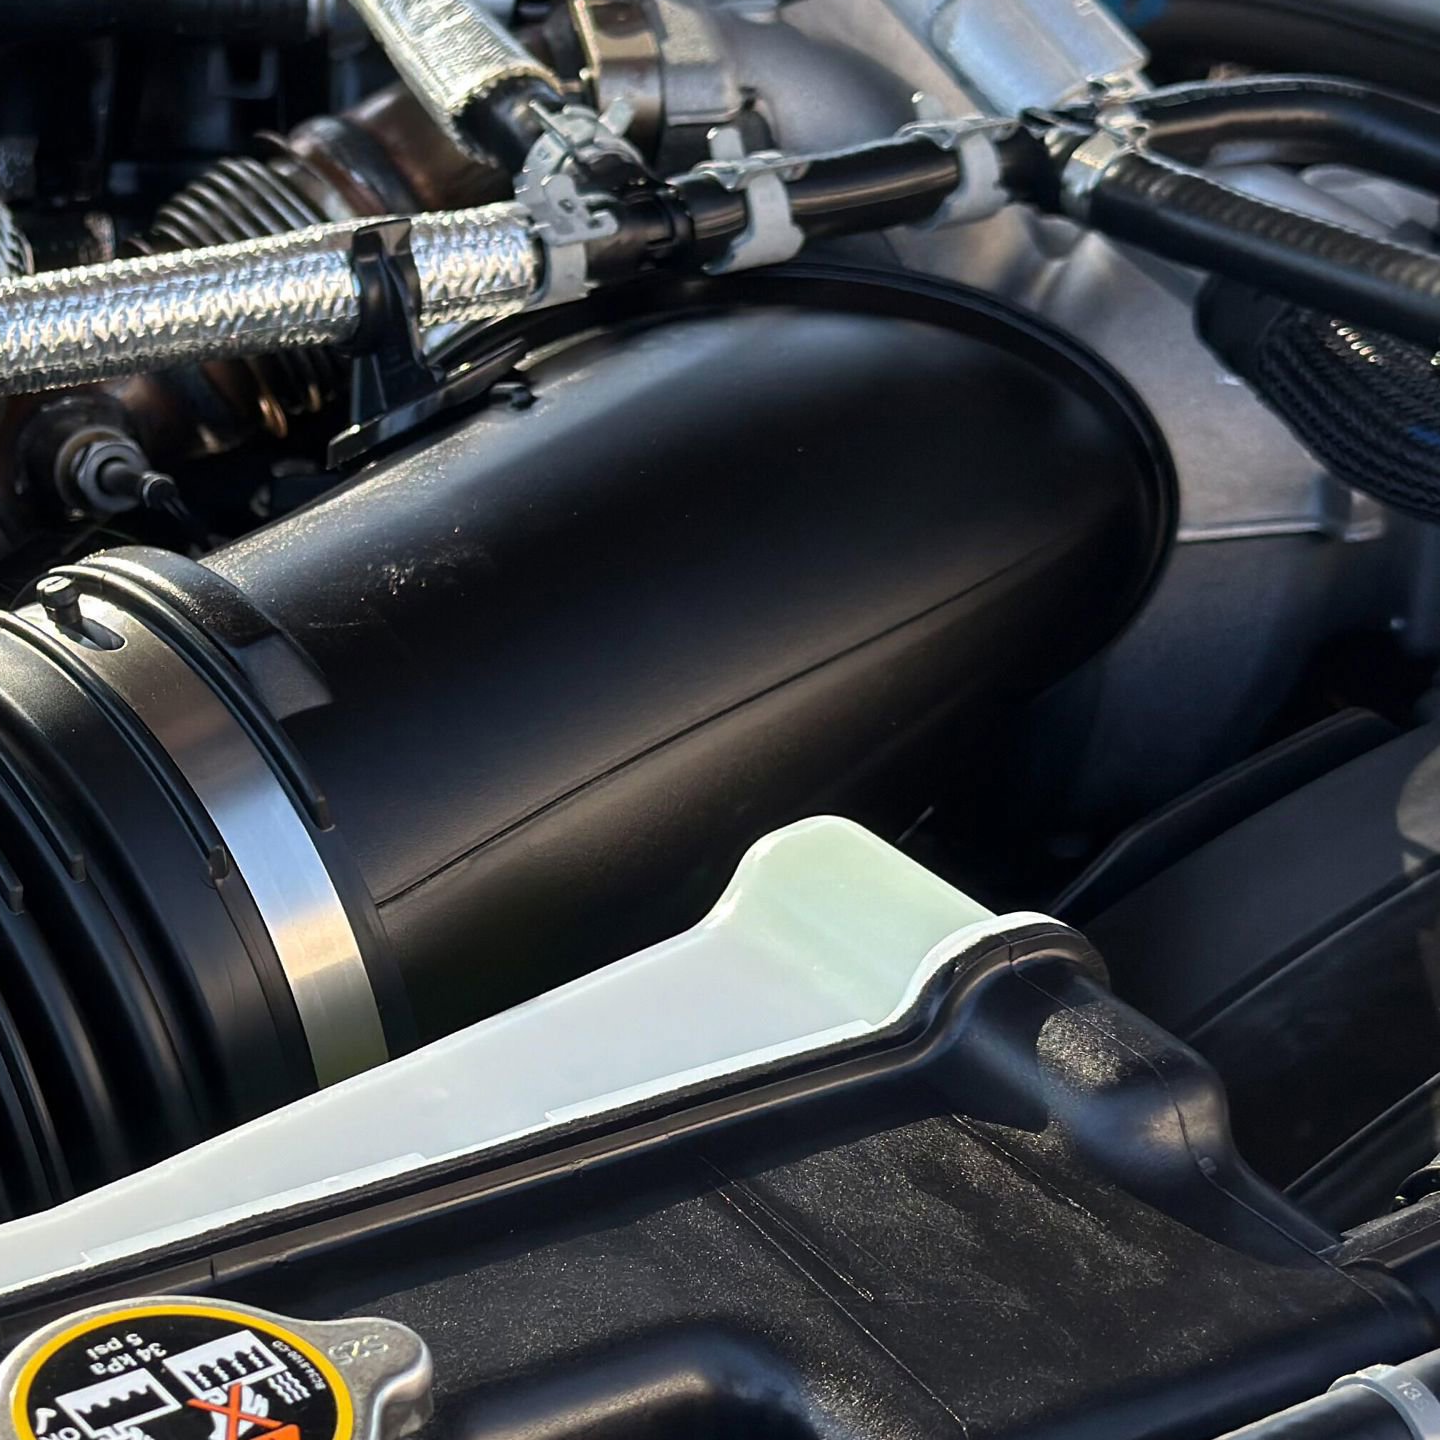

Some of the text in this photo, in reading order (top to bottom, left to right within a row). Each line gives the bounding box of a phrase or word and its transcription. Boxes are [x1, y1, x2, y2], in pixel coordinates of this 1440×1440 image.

[85, 1331, 143, 1361] 5 psi
[89, 1340, 168, 1378] 34 kPa
